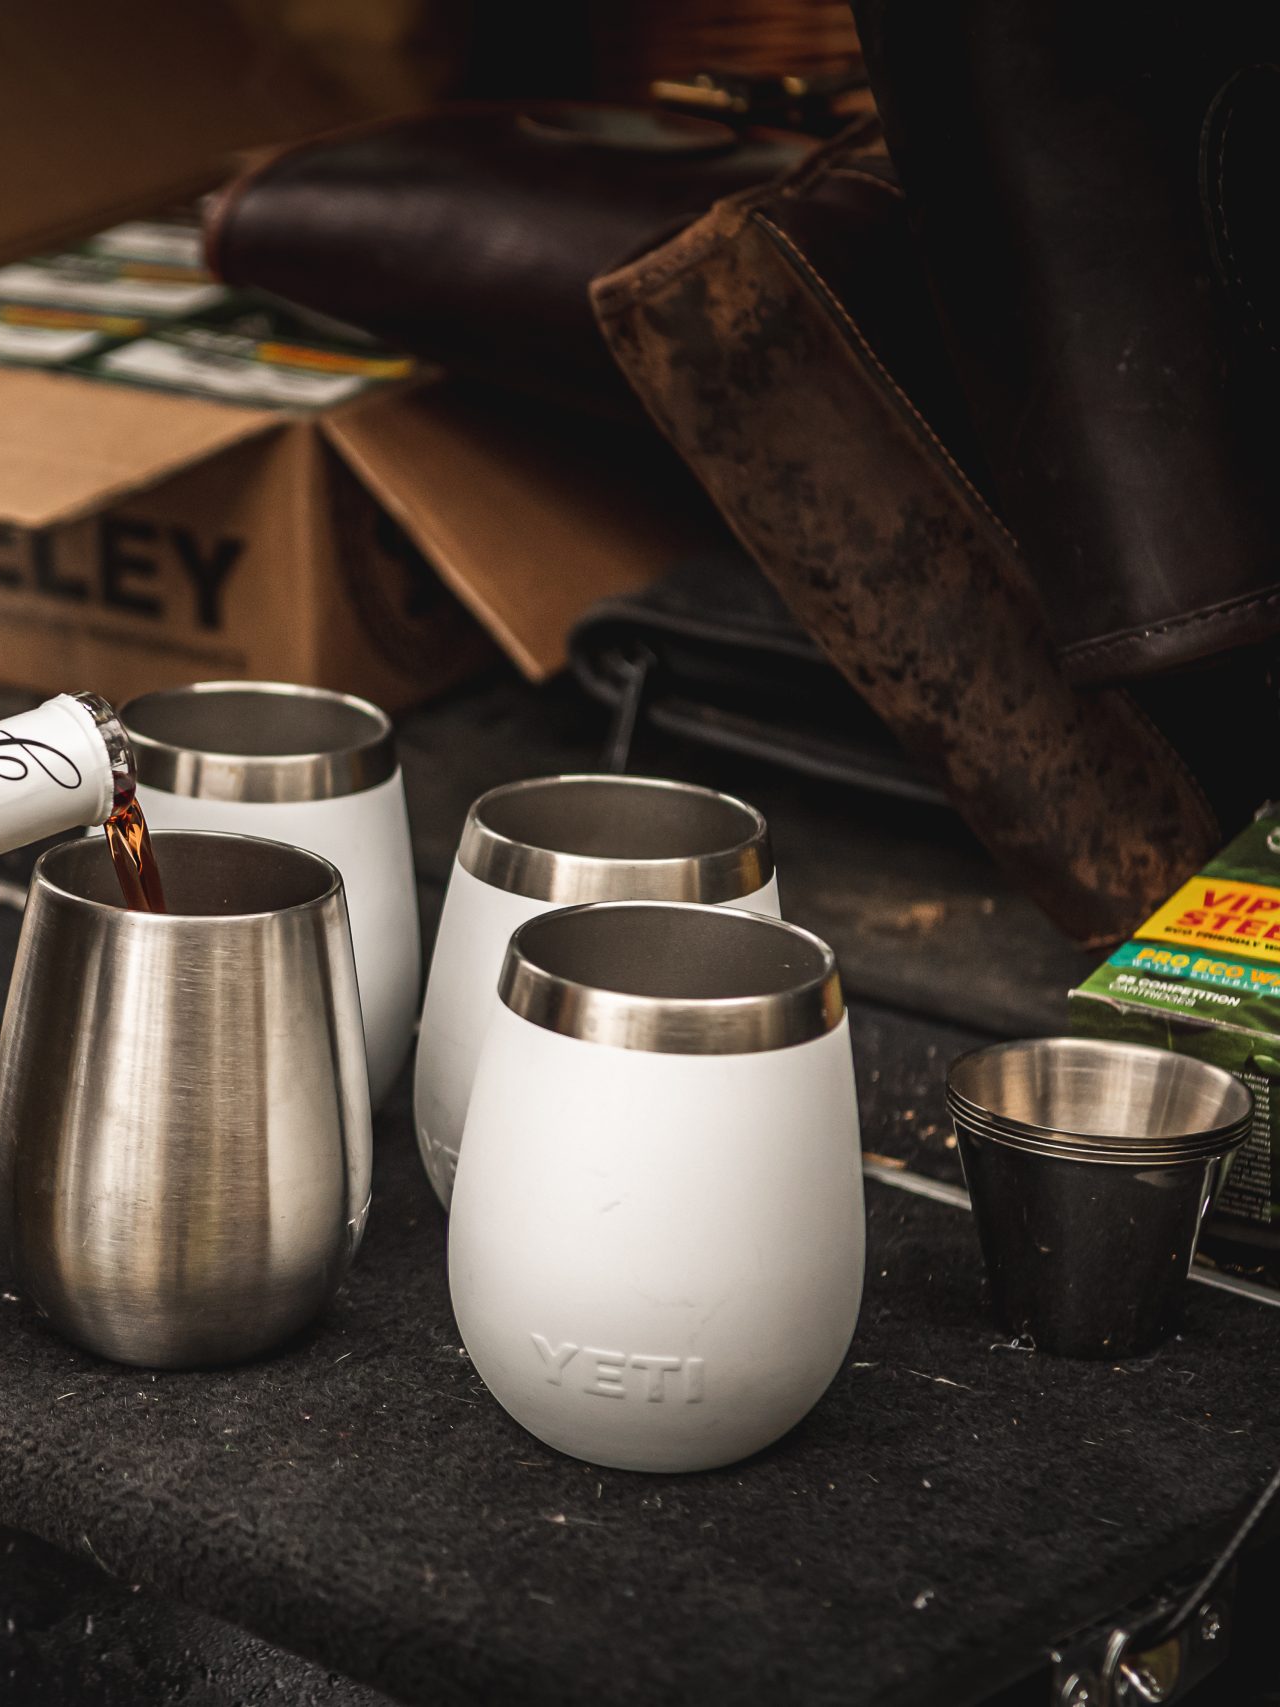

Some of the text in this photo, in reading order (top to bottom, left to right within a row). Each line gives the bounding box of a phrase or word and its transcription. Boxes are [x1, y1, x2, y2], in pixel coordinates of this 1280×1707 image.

[1203, 889, 1280, 914] VIP
[1131, 958, 1260, 990] WATER SOLUBLE
[1136, 947, 1190, 969] PRO
[1192, 957, 1245, 979] ECO
[1138, 977, 1241, 1008] COMPETITION
[530, 1332, 705, 1404] YETI
